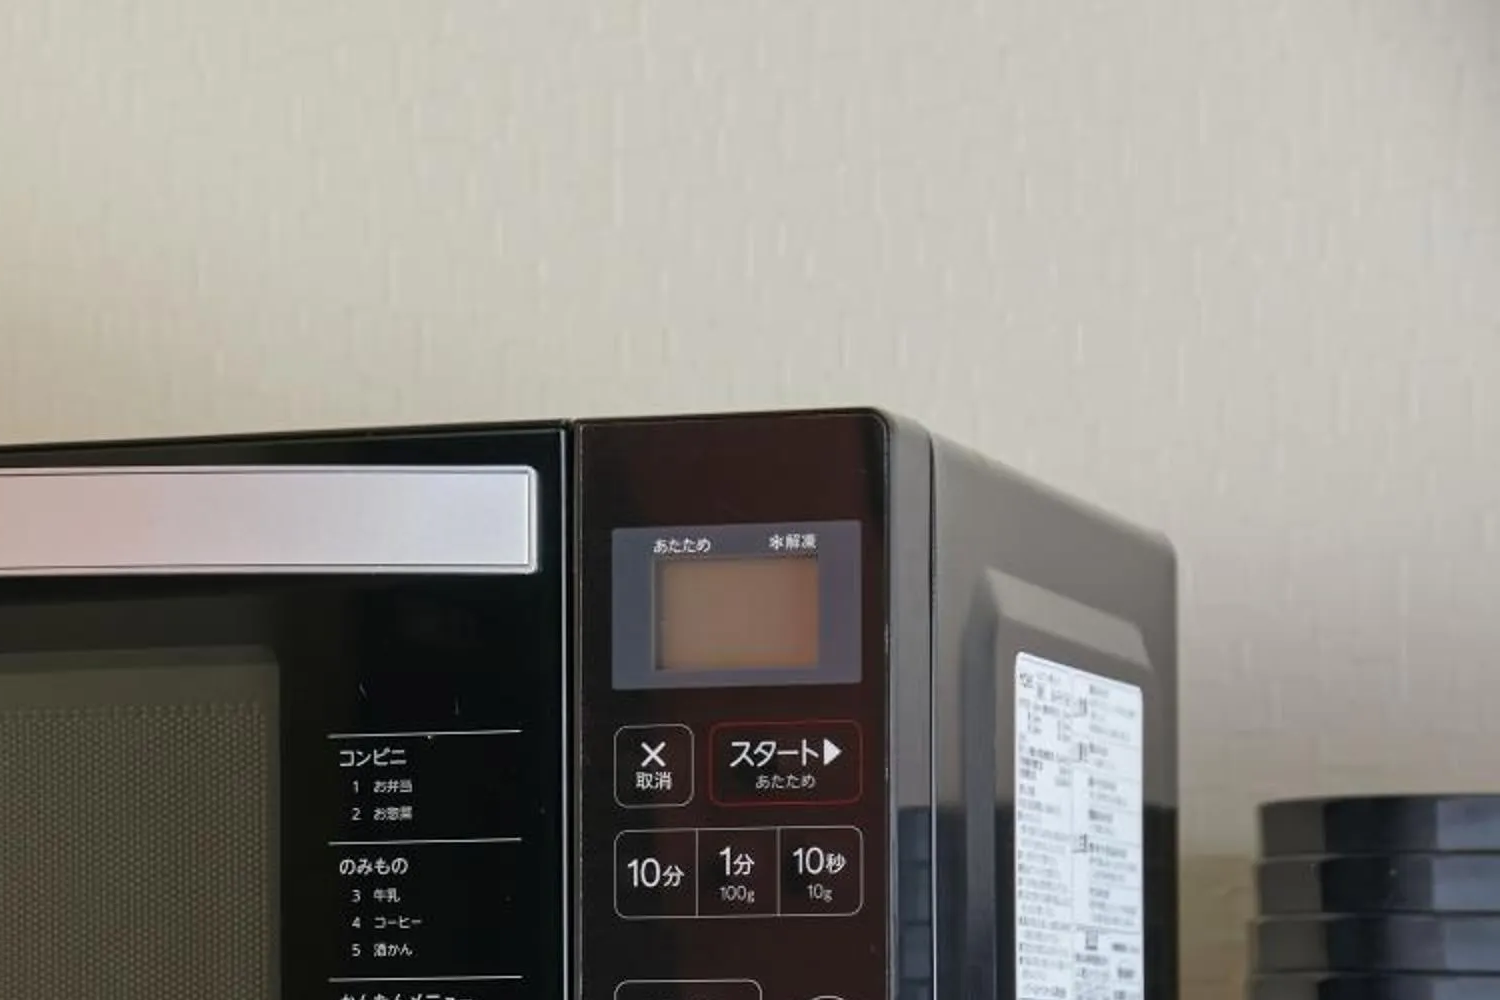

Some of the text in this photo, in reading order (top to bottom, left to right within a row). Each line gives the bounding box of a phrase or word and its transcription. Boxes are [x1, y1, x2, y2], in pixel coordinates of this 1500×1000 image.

[653, 537, 711, 554] あたため
[339, 747, 407, 767] コンビニ
[729, 738, 820, 768] スタート
[373, 779, 413, 793] お弁当
[635, 771, 673, 790] 取消
[755, 773, 816, 790] あたため
[339, 857, 409, 876] のみもの
[719, 846, 755, 876] 1分
[793, 846, 846, 875] 10秒
[627, 857, 685, 888] 10分
[373, 887, 401, 903] 牛乳
[719, 885, 755, 903] 100g
[807, 883, 833, 903] 10g
[374, 915, 422, 929] コーヒー
[373, 943, 413, 957] 酒かん
